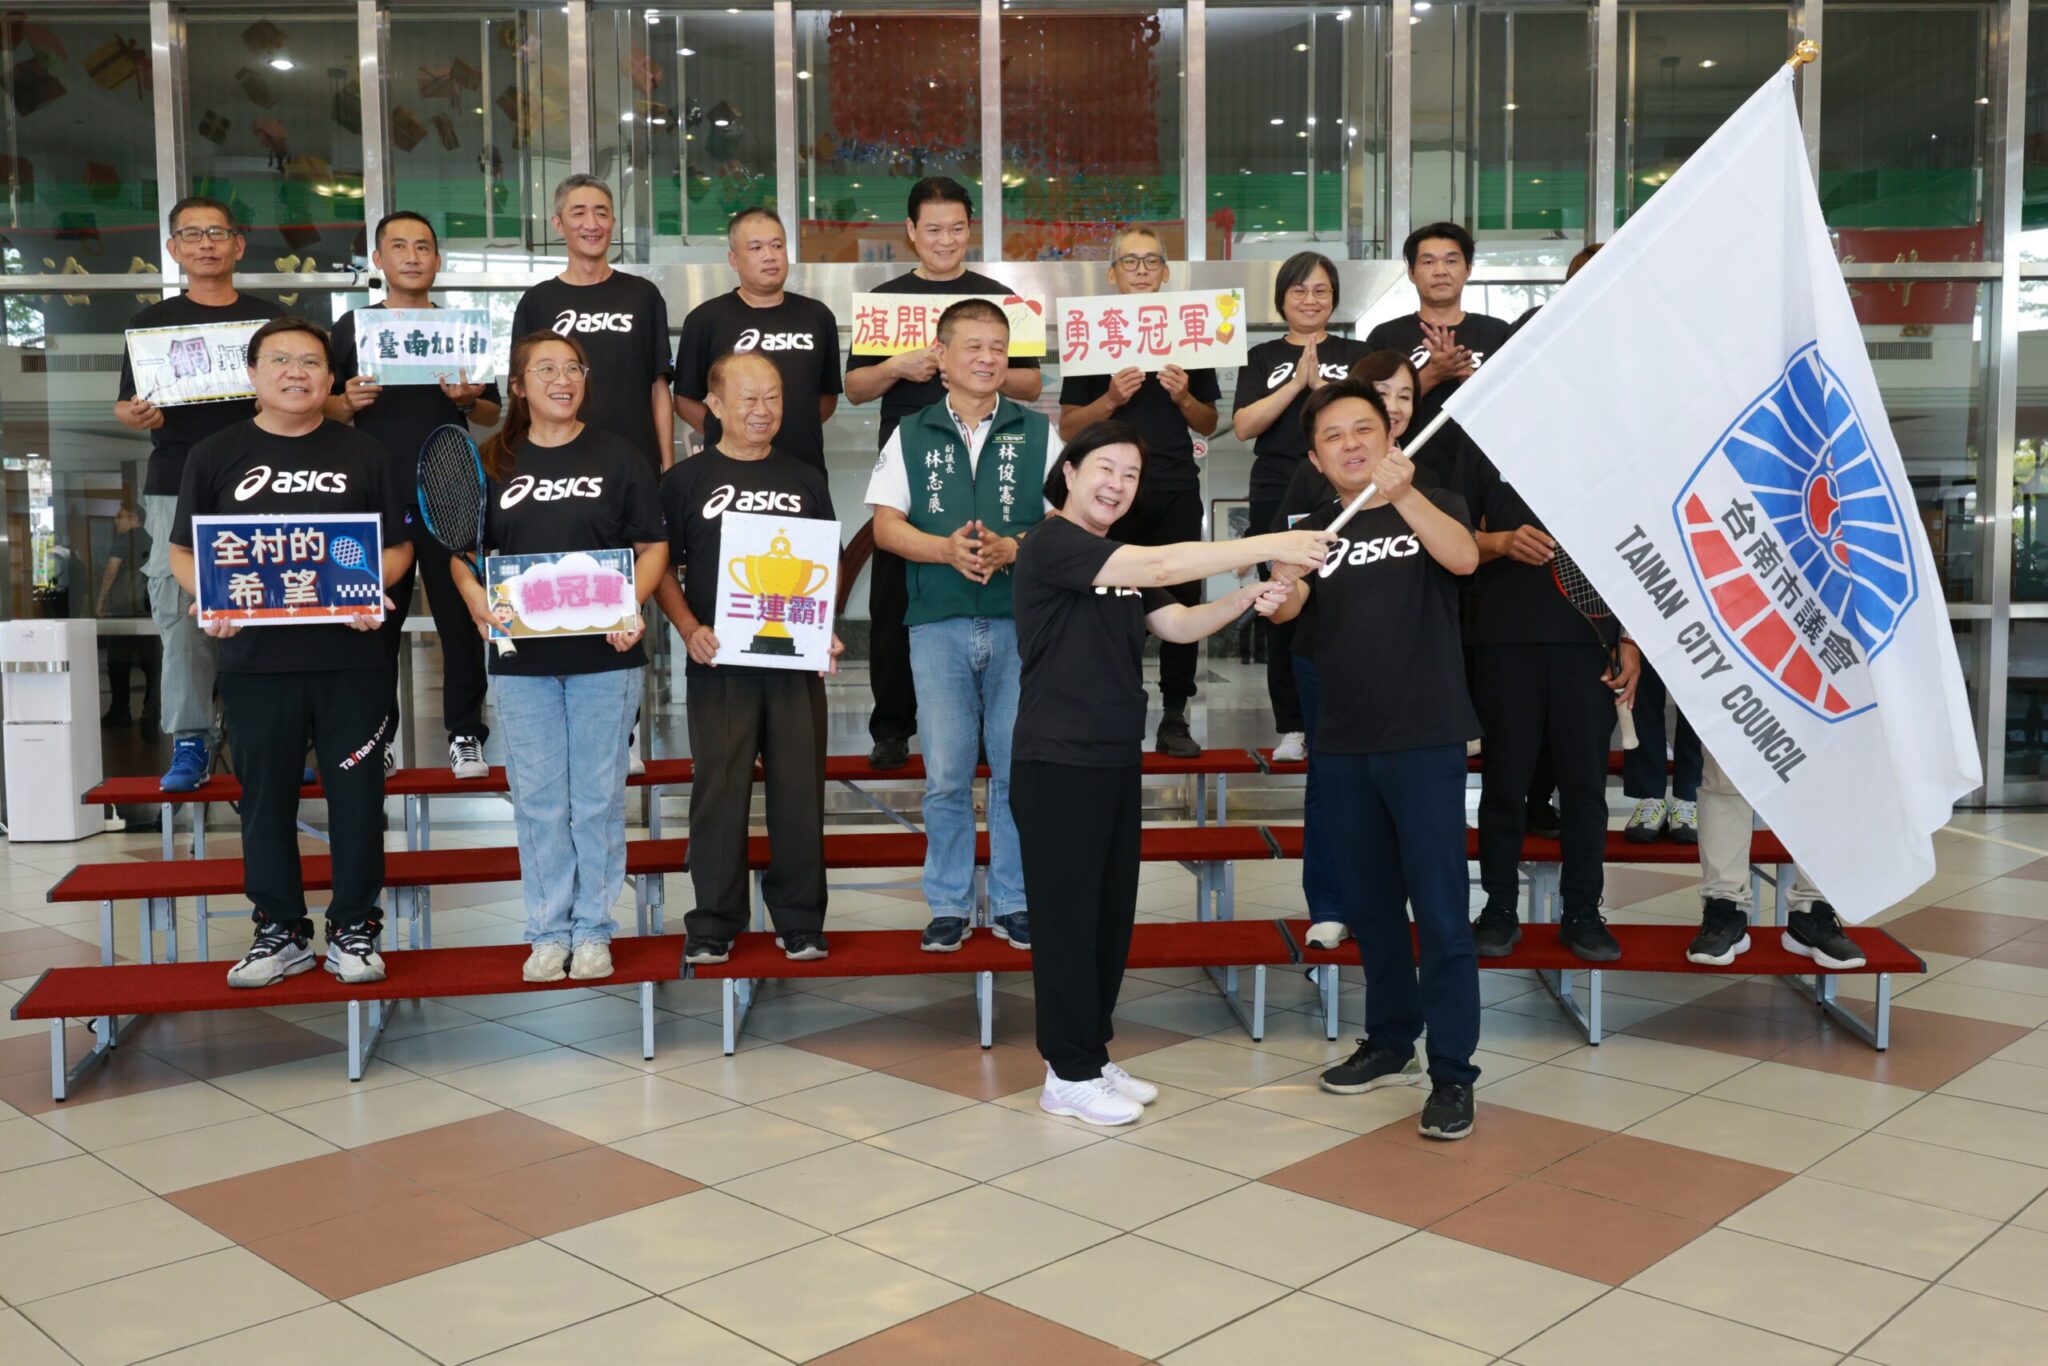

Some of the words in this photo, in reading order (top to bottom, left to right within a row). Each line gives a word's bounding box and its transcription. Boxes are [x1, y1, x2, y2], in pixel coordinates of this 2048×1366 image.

[377, 329, 487, 359] 臺南加油
[1062, 303, 1214, 363] 勇奪冠軍
[924, 449, 945, 515] 林志展
[211, 527, 327, 567] 全村的
[521, 575, 625, 615] 總冠軍
[1720, 497, 1861, 676] 台南市議會
[1614, 523, 1690, 620] TAINAN
[1676, 620, 1733, 681] CITY
[1720, 684, 1808, 784] COUNCIL
